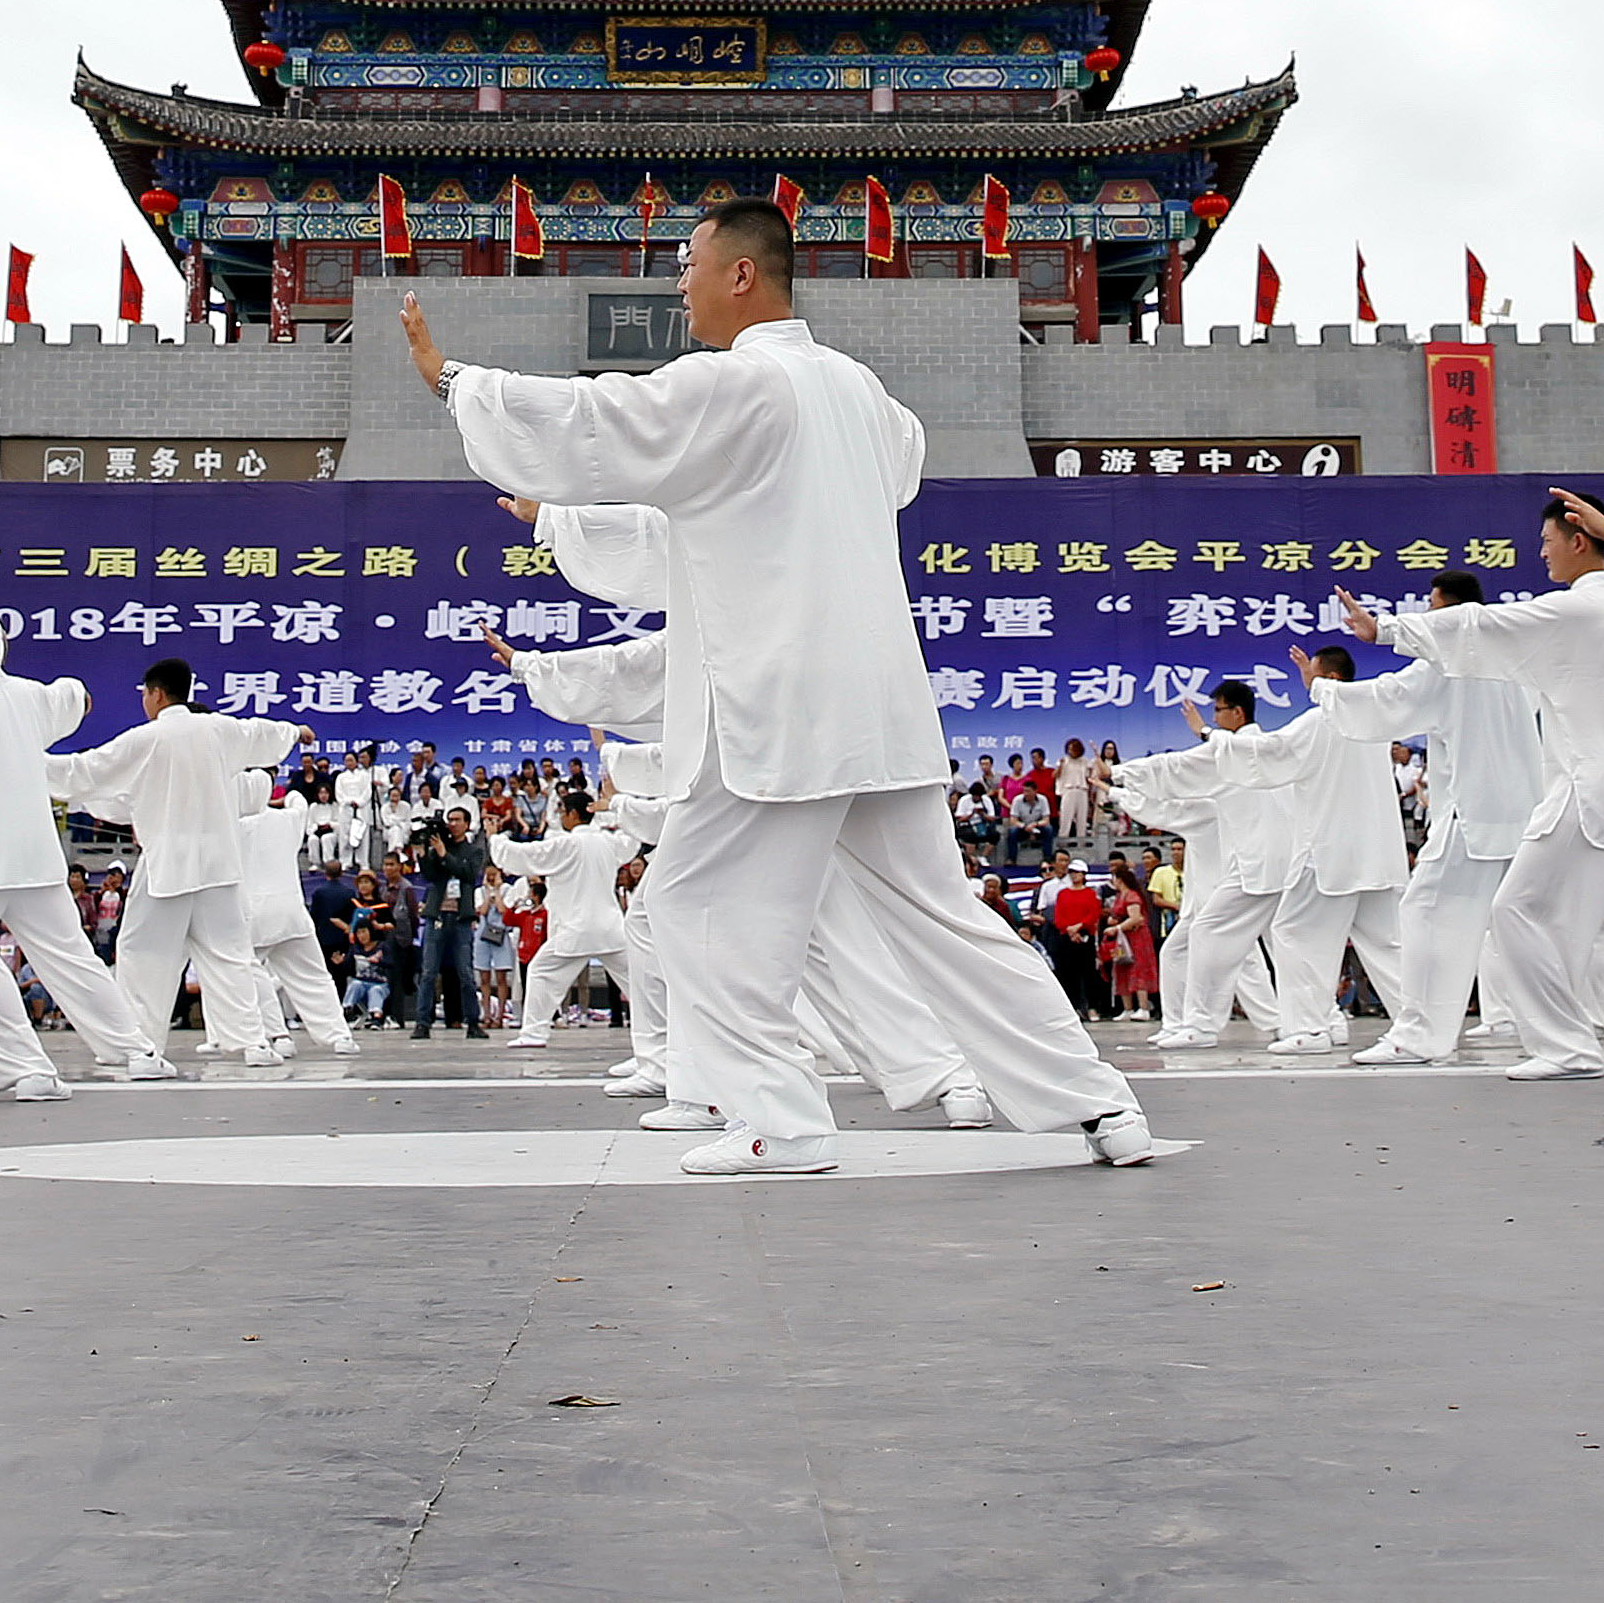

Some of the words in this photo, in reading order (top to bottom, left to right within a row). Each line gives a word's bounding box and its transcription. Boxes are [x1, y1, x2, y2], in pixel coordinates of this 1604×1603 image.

[105, 447, 267, 478] 票务中心
[1100, 448, 1282, 474] 游客中心
[918, 538, 1516, 574] 化博览会平凉分会场
